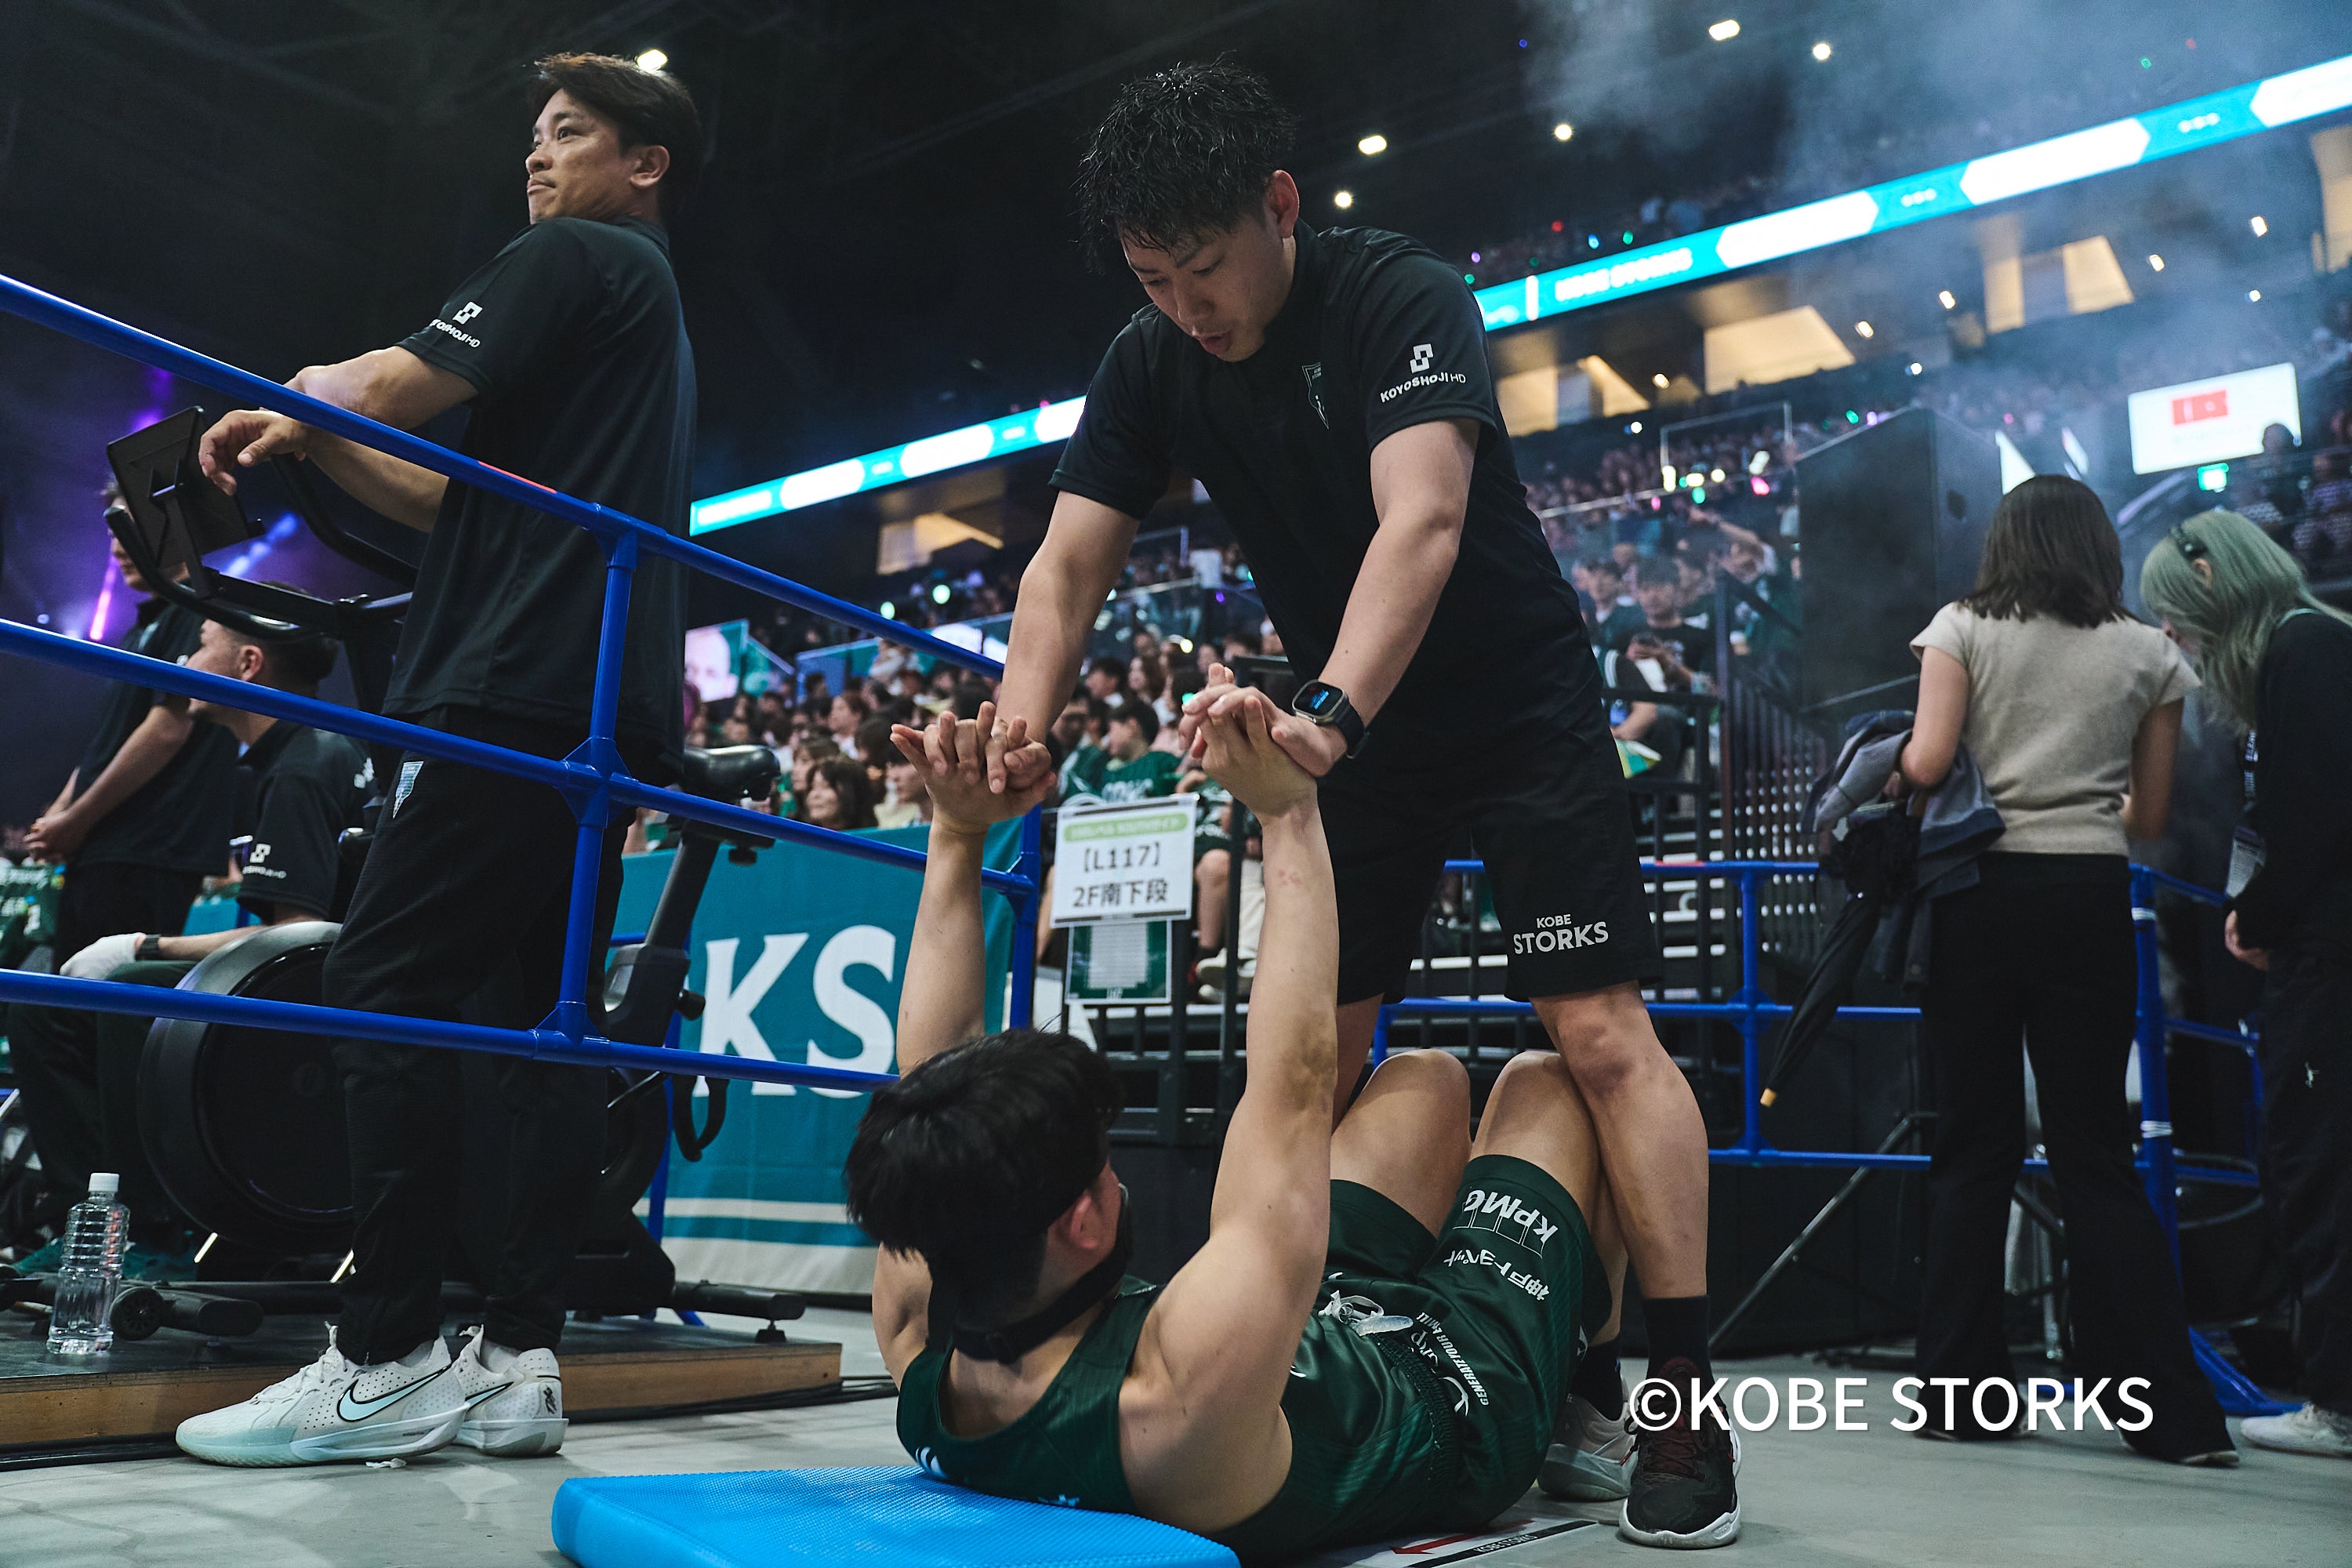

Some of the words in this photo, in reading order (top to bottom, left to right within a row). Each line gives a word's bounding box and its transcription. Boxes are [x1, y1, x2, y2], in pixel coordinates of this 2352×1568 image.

[465, 336, 481, 348] HD
[1380, 372, 1449, 403] KOYOSHOJI
[1450, 373, 1467, 383] HD
[1073, 878, 1168, 908] 2F南下段
[1536, 913, 1572, 928] KOBE
[1513, 921, 1609, 955] STORKS
[1463, 1189, 1559, 1243] KPMG
[1443, 1249, 1549, 1301] 神戸トヨペット
[1436, 1334, 1461, 1359] YOUR
[1452, 1358, 1490, 1406] GENERATE
